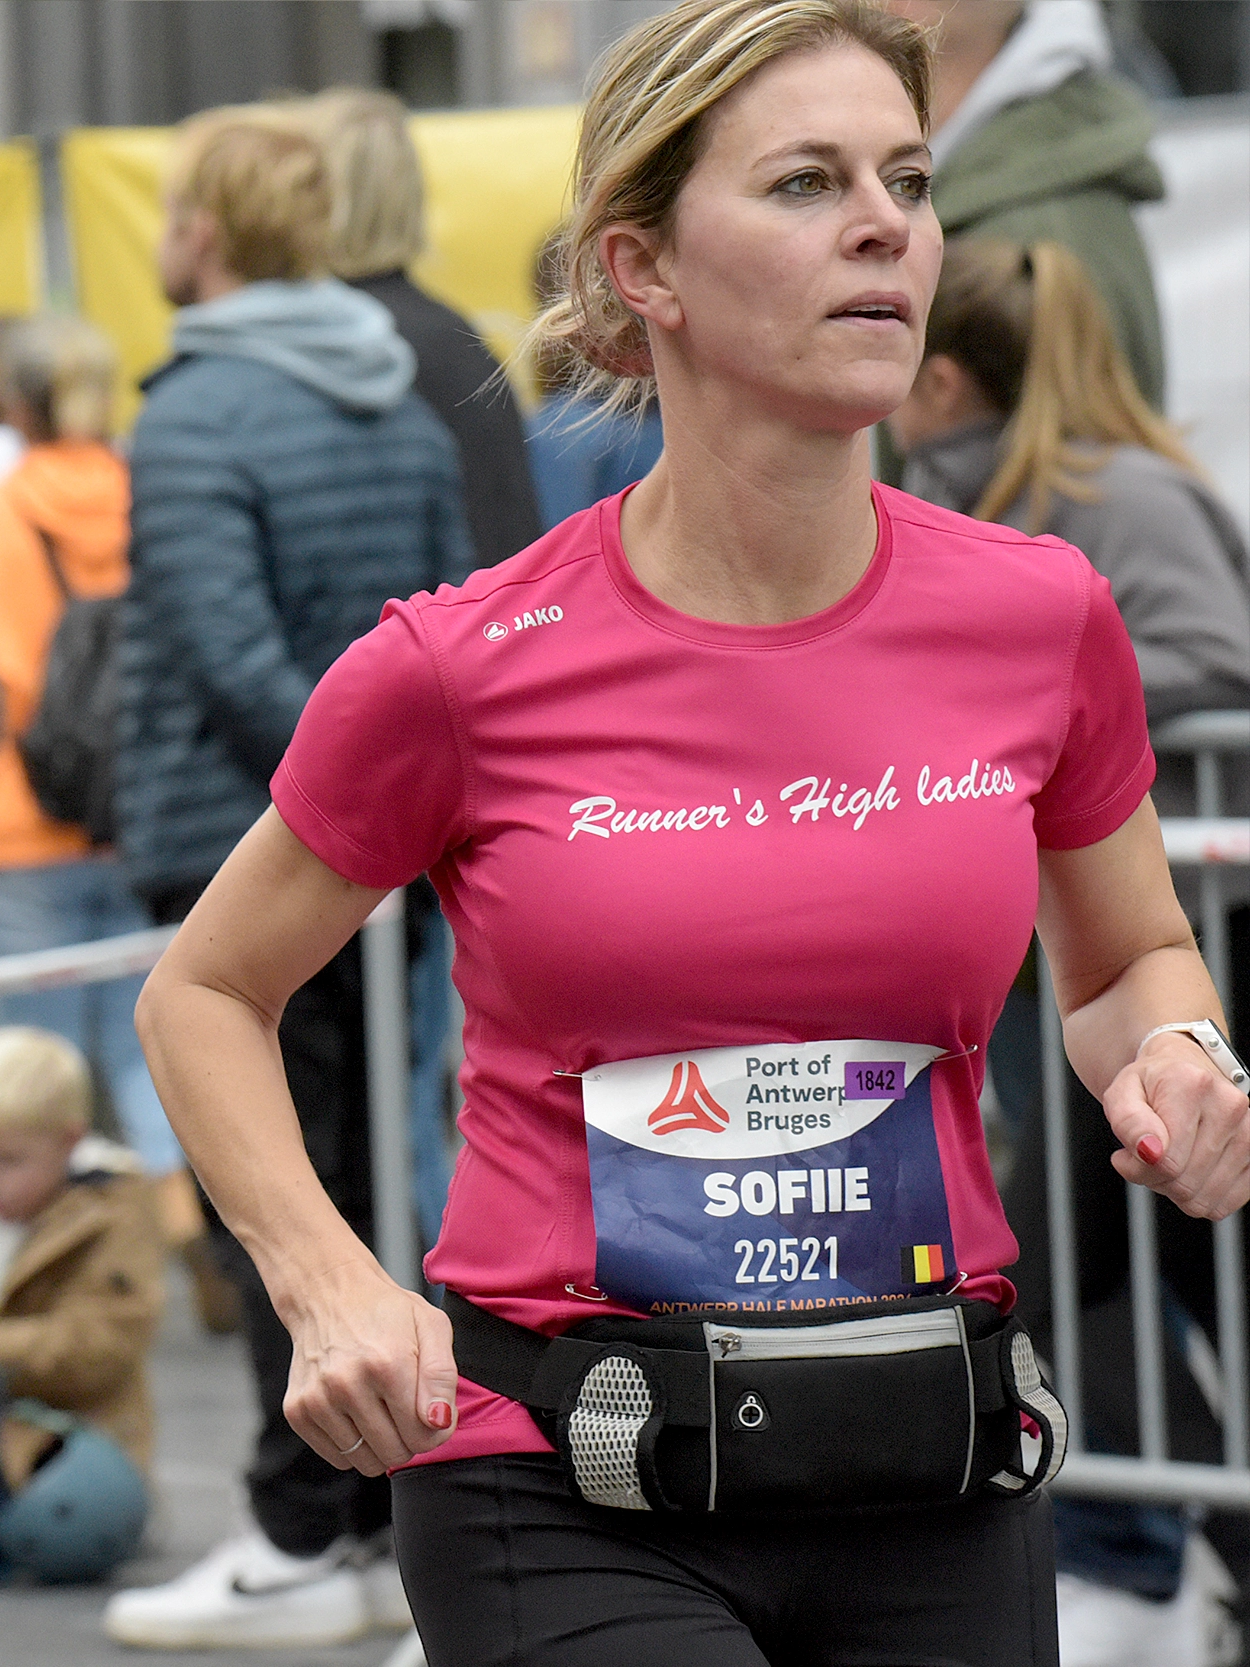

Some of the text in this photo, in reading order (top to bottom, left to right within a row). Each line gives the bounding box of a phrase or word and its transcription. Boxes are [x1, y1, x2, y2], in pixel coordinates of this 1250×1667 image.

[513, 605, 564, 631] JAKO
[567, 758, 1016, 841] Runner's High ladies
[746, 1054, 831, 1077] Port of
[856, 1070, 895, 1091] 1842
[747, 1111, 831, 1135] Bruges
[703, 1167, 871, 1217] SOFIIE
[734, 1236, 839, 1284] 22521
